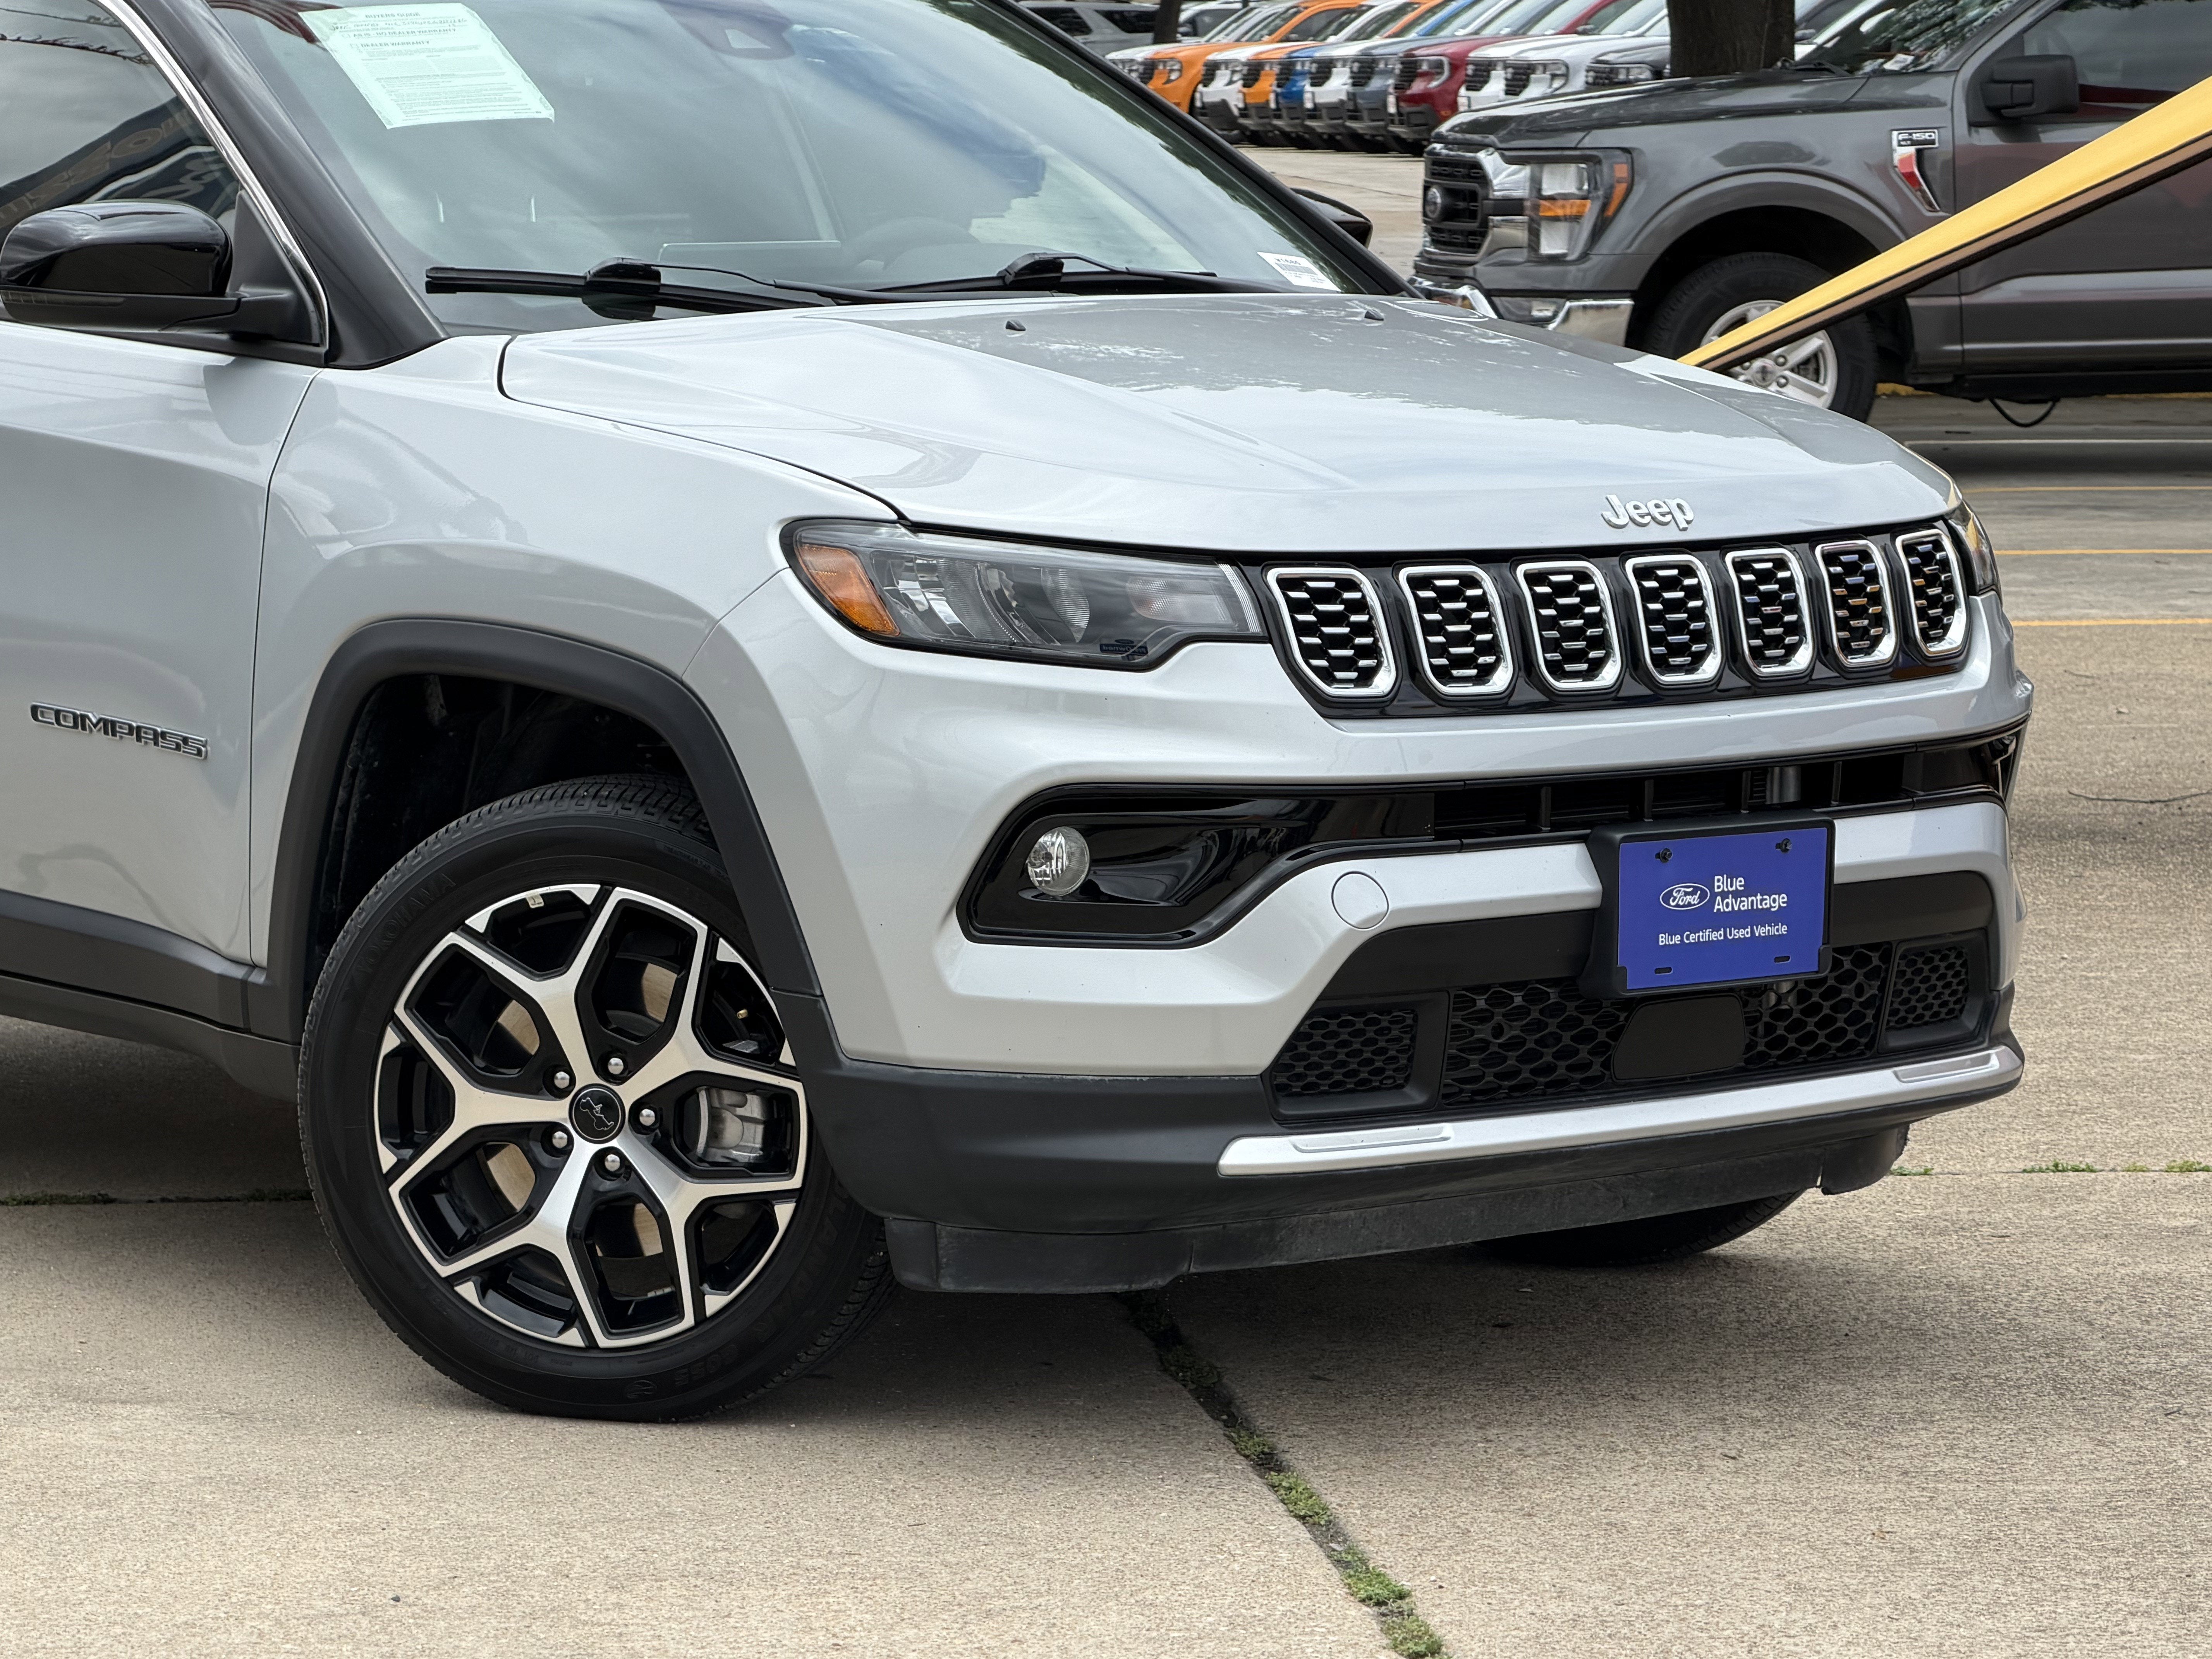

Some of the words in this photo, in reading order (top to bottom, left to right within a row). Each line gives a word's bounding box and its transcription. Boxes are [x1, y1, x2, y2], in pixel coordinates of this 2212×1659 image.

[1601, 494, 1694, 531] Jeep
[30, 702, 208, 760] COMPASS
[1714, 874, 1745, 892] Blue
[1669, 887, 1700, 906] Ford
[1714, 893, 1788, 912] Advantage
[1659, 933, 1681, 945] Blue
[1684, 928, 1724, 943] Certified
[1727, 926, 1751, 939] Used
[1754, 922, 1788, 936] Vehicle
